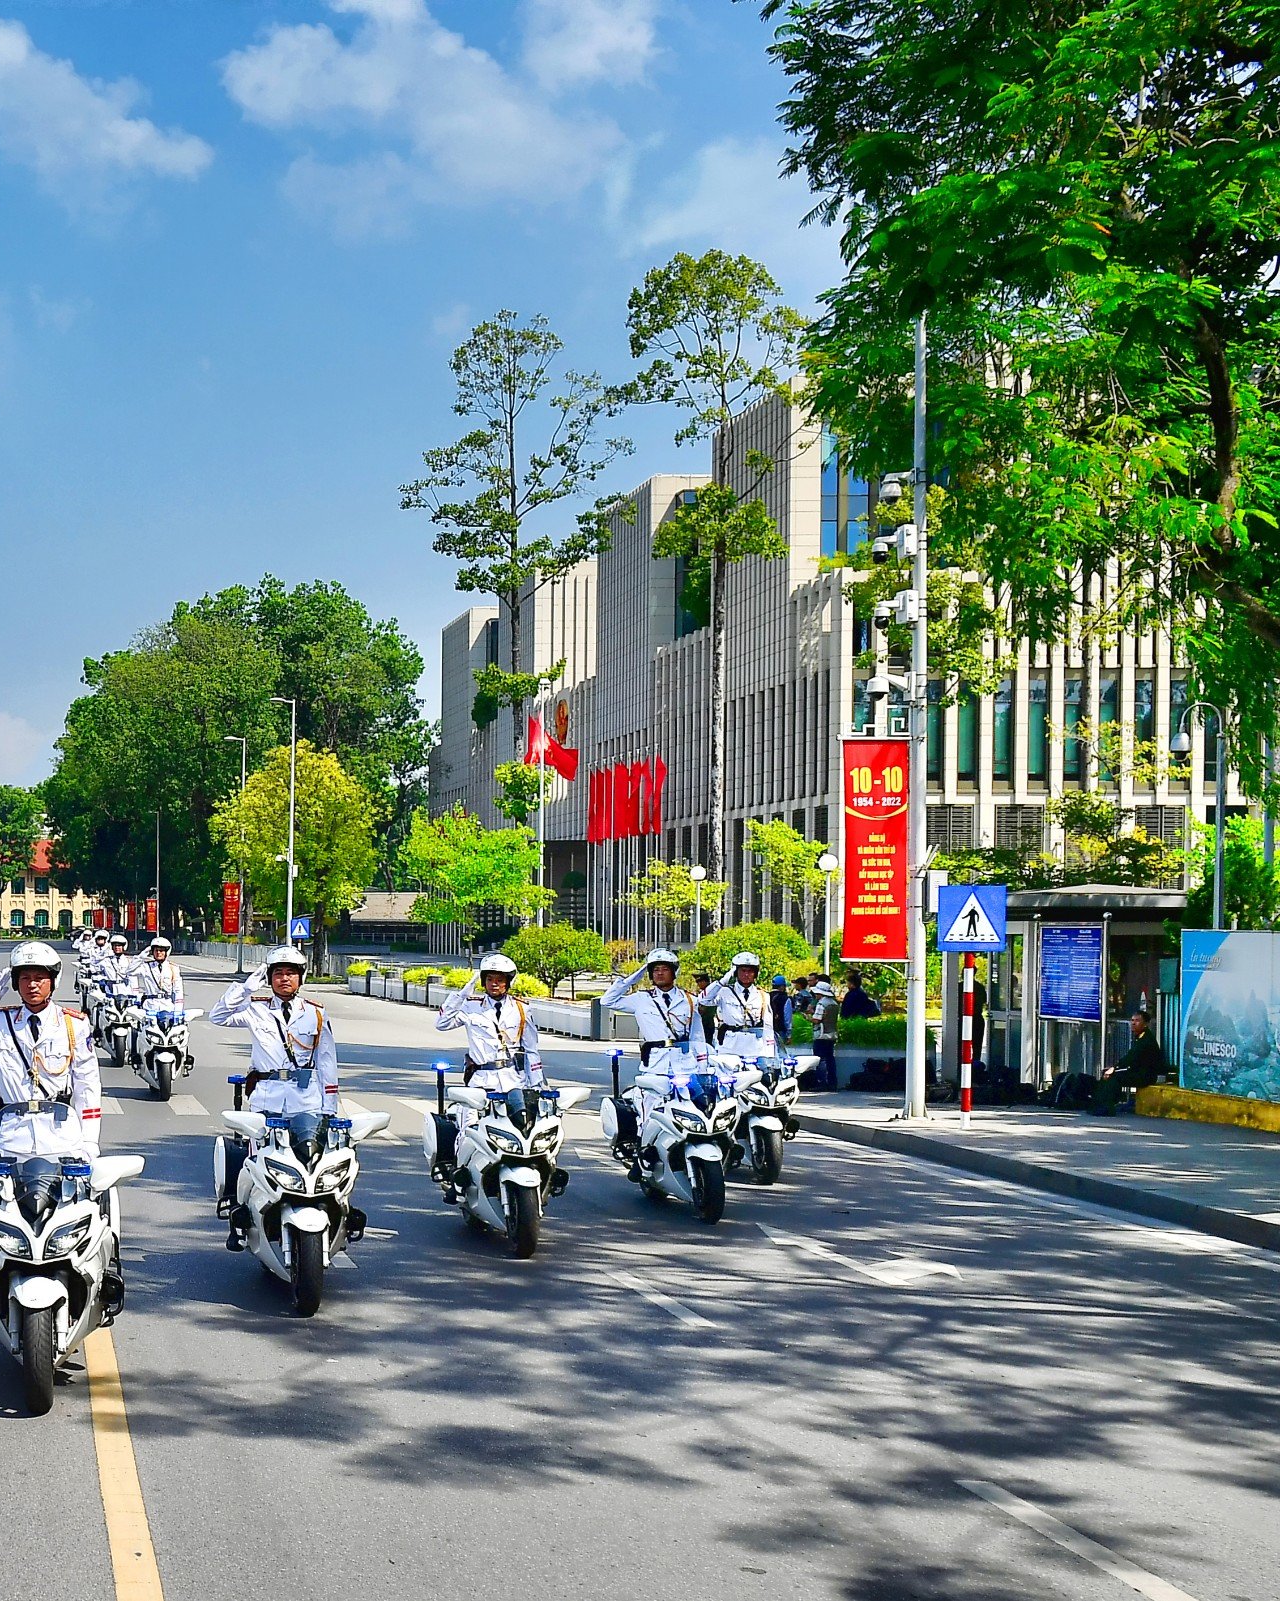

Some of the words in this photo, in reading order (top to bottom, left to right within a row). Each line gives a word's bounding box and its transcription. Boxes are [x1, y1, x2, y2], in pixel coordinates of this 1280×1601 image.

[852, 797, 874, 807] 1954
[881, 796, 901, 807] 2022
[1193, 1026, 1205, 1040] 40
[1204, 1042, 1237, 1058] UNESCO
